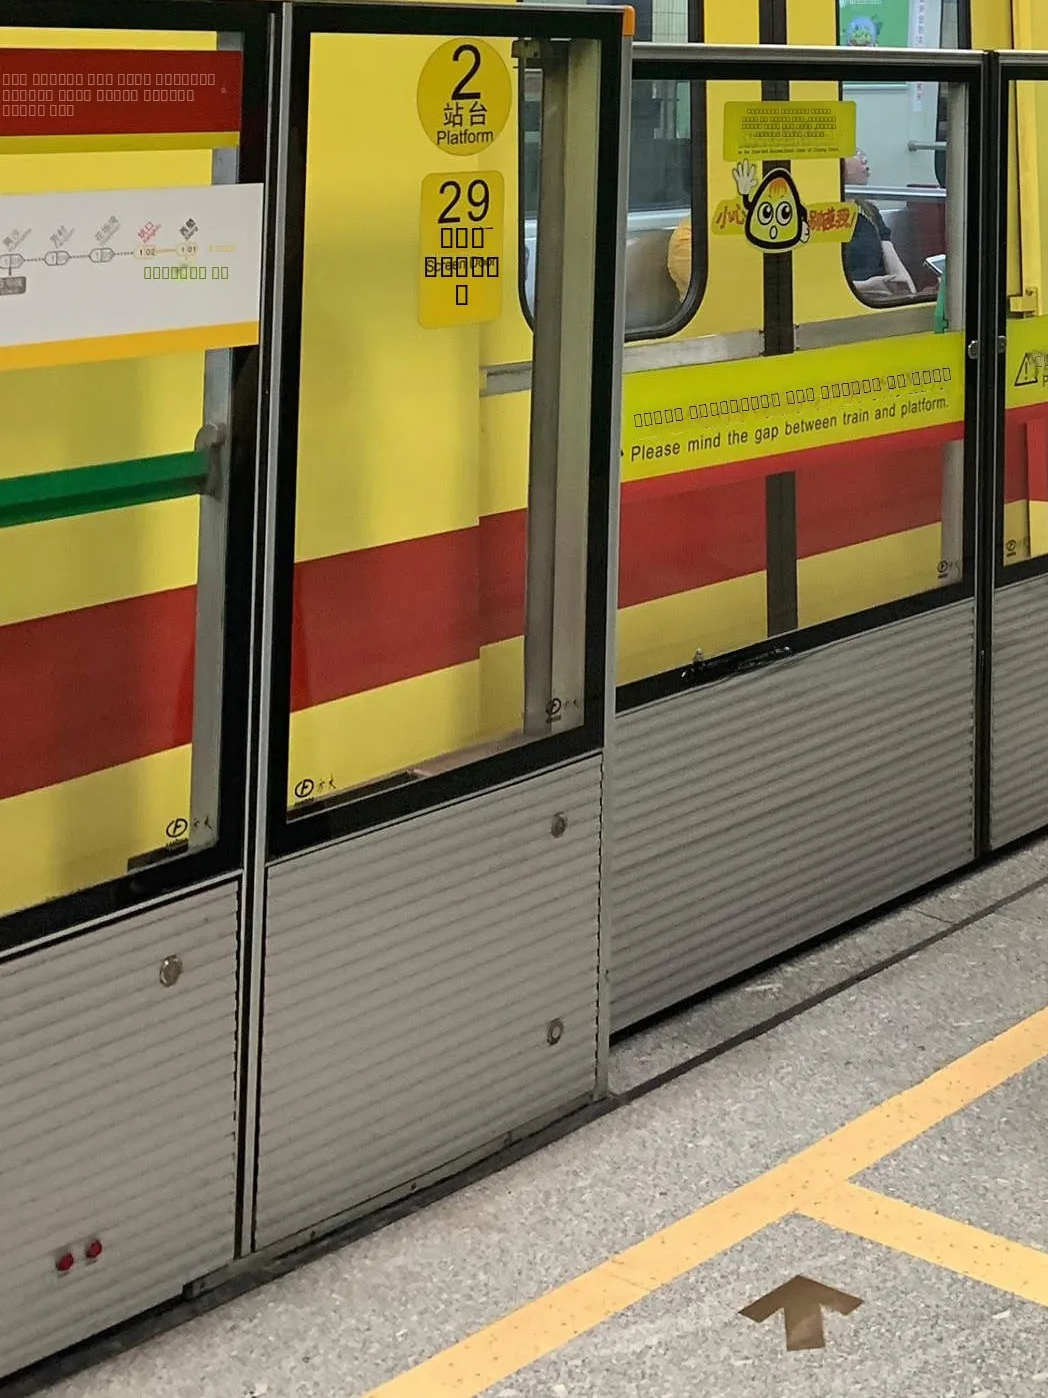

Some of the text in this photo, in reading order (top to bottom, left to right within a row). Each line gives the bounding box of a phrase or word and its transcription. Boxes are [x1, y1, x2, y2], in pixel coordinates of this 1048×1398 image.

[451, 44, 483, 101] 2
[444, 101, 488, 127] 站台
[437, 130, 494, 146] Platform
[437, 179, 491, 224] 29
[631, 397, 949, 463] Please mind the gap between train and platform.
